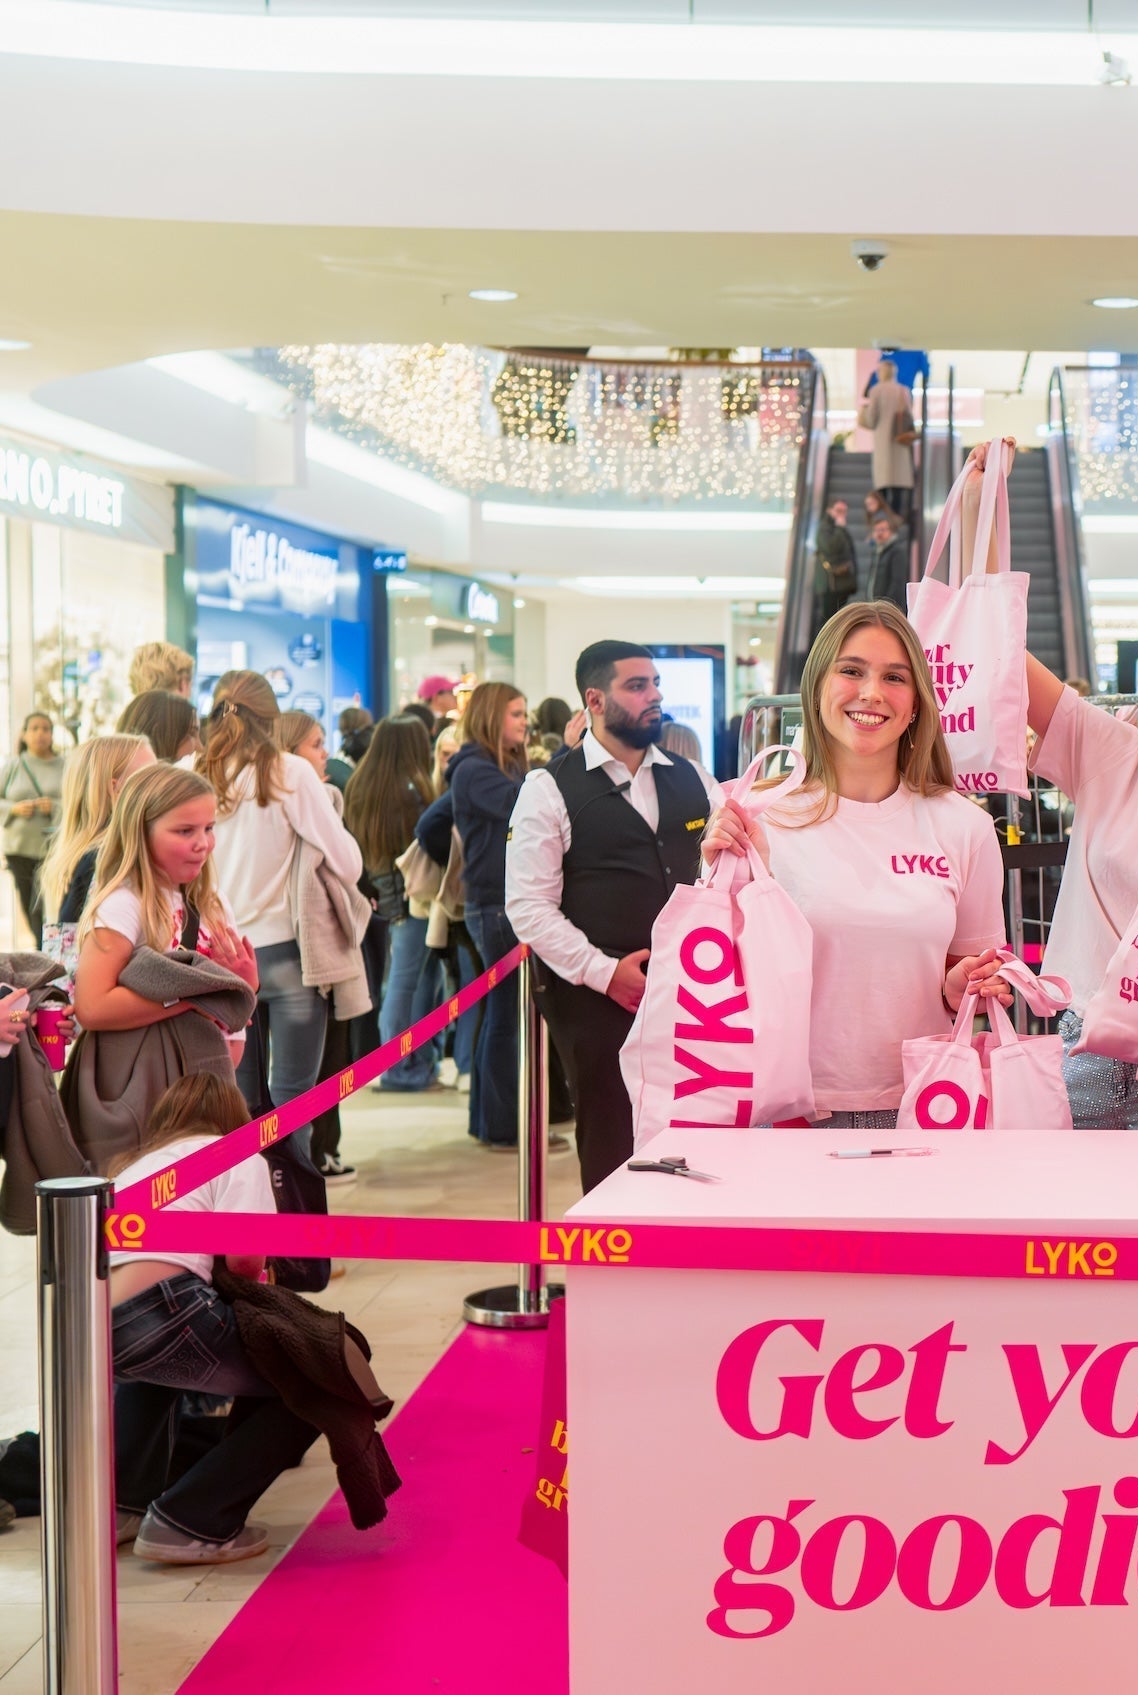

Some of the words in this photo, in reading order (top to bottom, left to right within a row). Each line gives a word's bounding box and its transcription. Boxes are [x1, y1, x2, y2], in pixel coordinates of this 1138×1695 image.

[891, 854, 950, 879] LYKO
[669, 926, 754, 1129] LYKO
[339, 1069, 355, 1100] LYKO
[260, 1113, 279, 1148] LYKO
[151, 1168, 177, 1210] LYKO
[539, 1227, 633, 1263] LYKO
[1025, 1241, 1118, 1276] LYKO
[716, 1319, 967, 1441] Get
